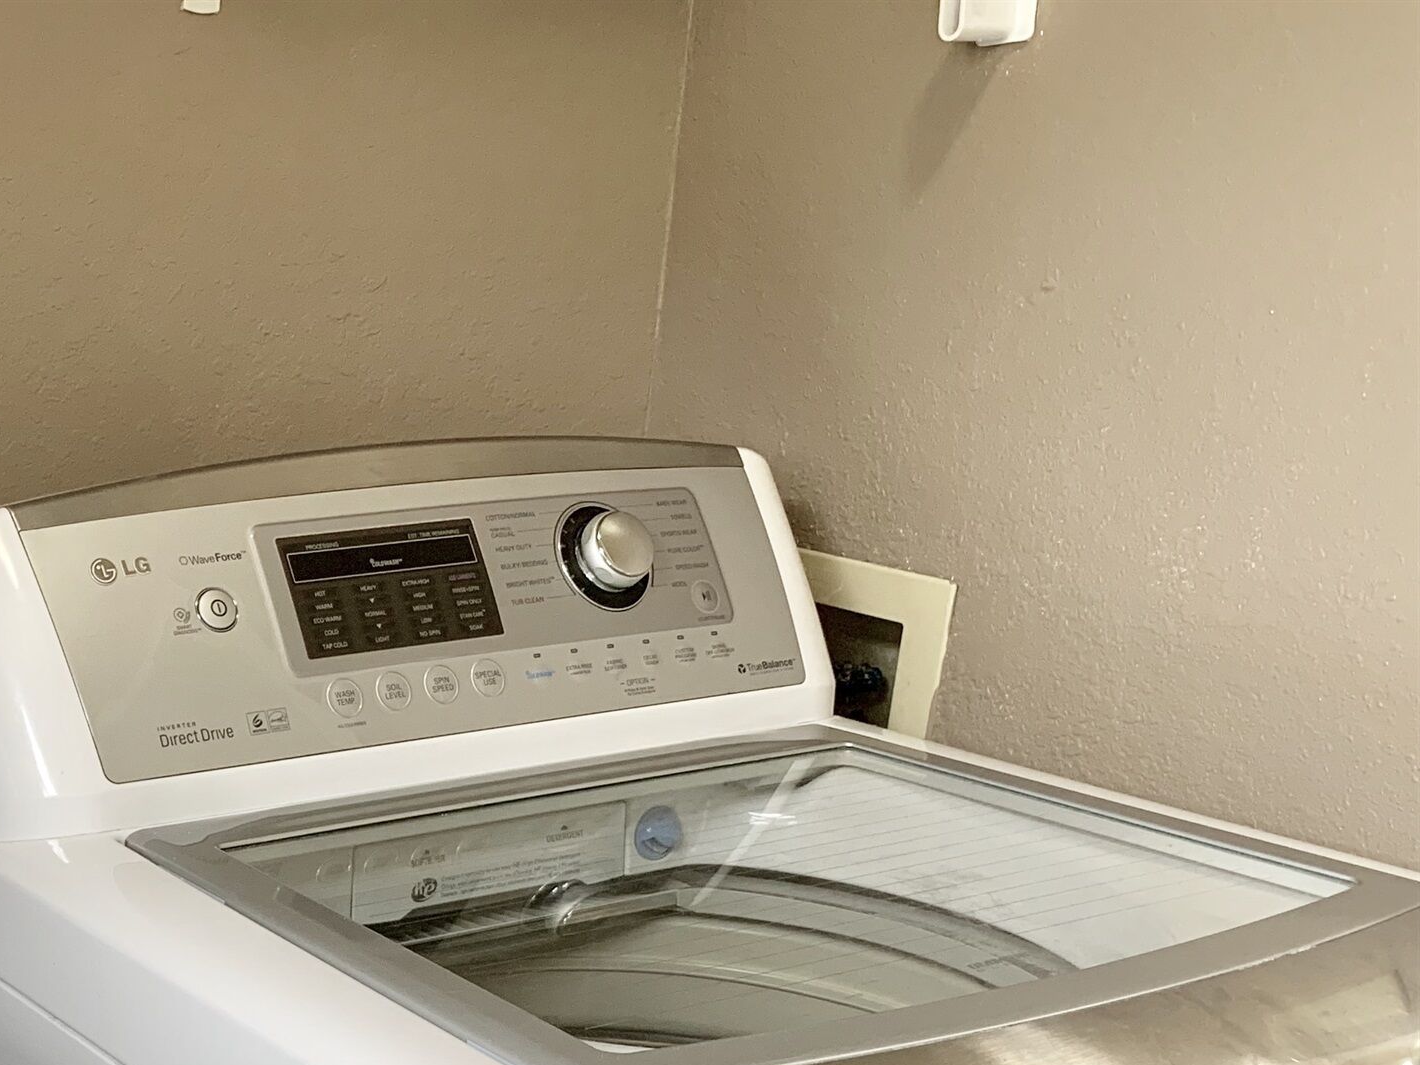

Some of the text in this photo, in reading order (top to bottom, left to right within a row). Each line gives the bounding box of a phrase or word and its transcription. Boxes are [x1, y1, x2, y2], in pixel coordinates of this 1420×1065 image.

[306, 542, 339, 550] PROCESSING
[121, 556, 151, 576] LG
[524, 596, 545, 604] CLEAN
[474, 670, 501, 679] SPECIAL
[434, 676, 450, 685] SPIN
[483, 678, 497, 686] USE
[386, 684, 402, 692] SOIL
[432, 684, 454, 694] SPEED
[334, 690, 356, 699] WASH
[385, 692, 406, 700] LEVEL
[157, 722, 196, 731] INVERTER
[160, 726, 234, 748] Direct Drive
